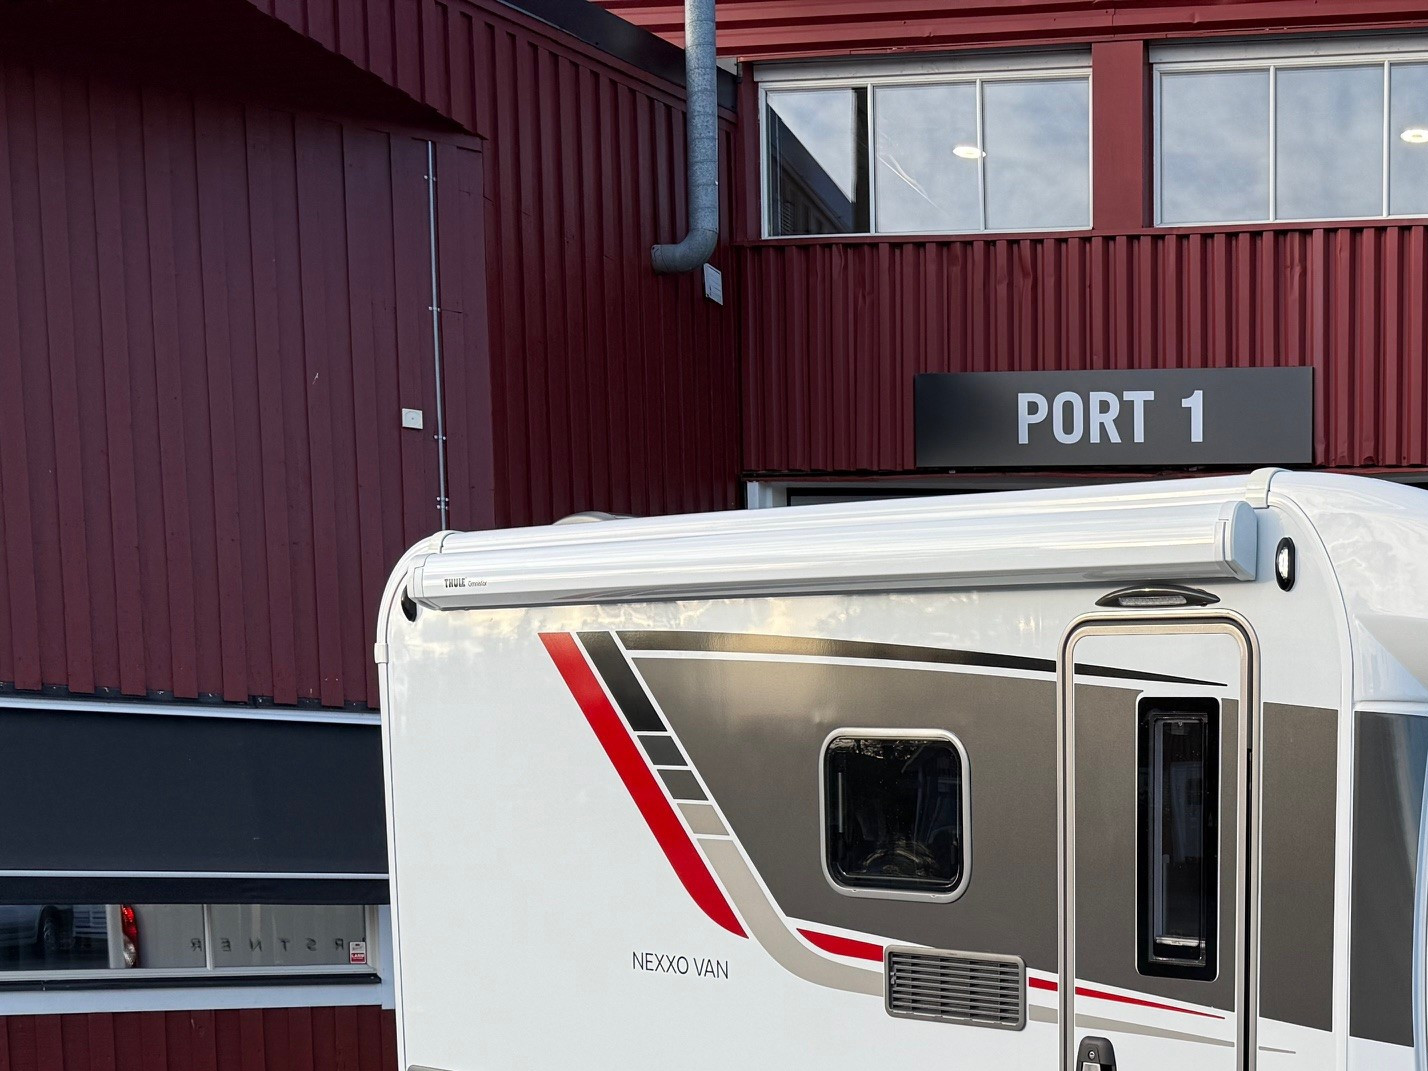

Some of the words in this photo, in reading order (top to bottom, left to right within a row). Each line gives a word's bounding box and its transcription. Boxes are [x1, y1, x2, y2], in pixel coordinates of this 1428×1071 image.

[1018, 390, 1155, 445] PORT
[1182, 390, 1205, 443] 1
[444, 577, 466, 588] THULE
[632, 952, 689, 975] NEXXO
[693, 957, 729, 979] VAN
